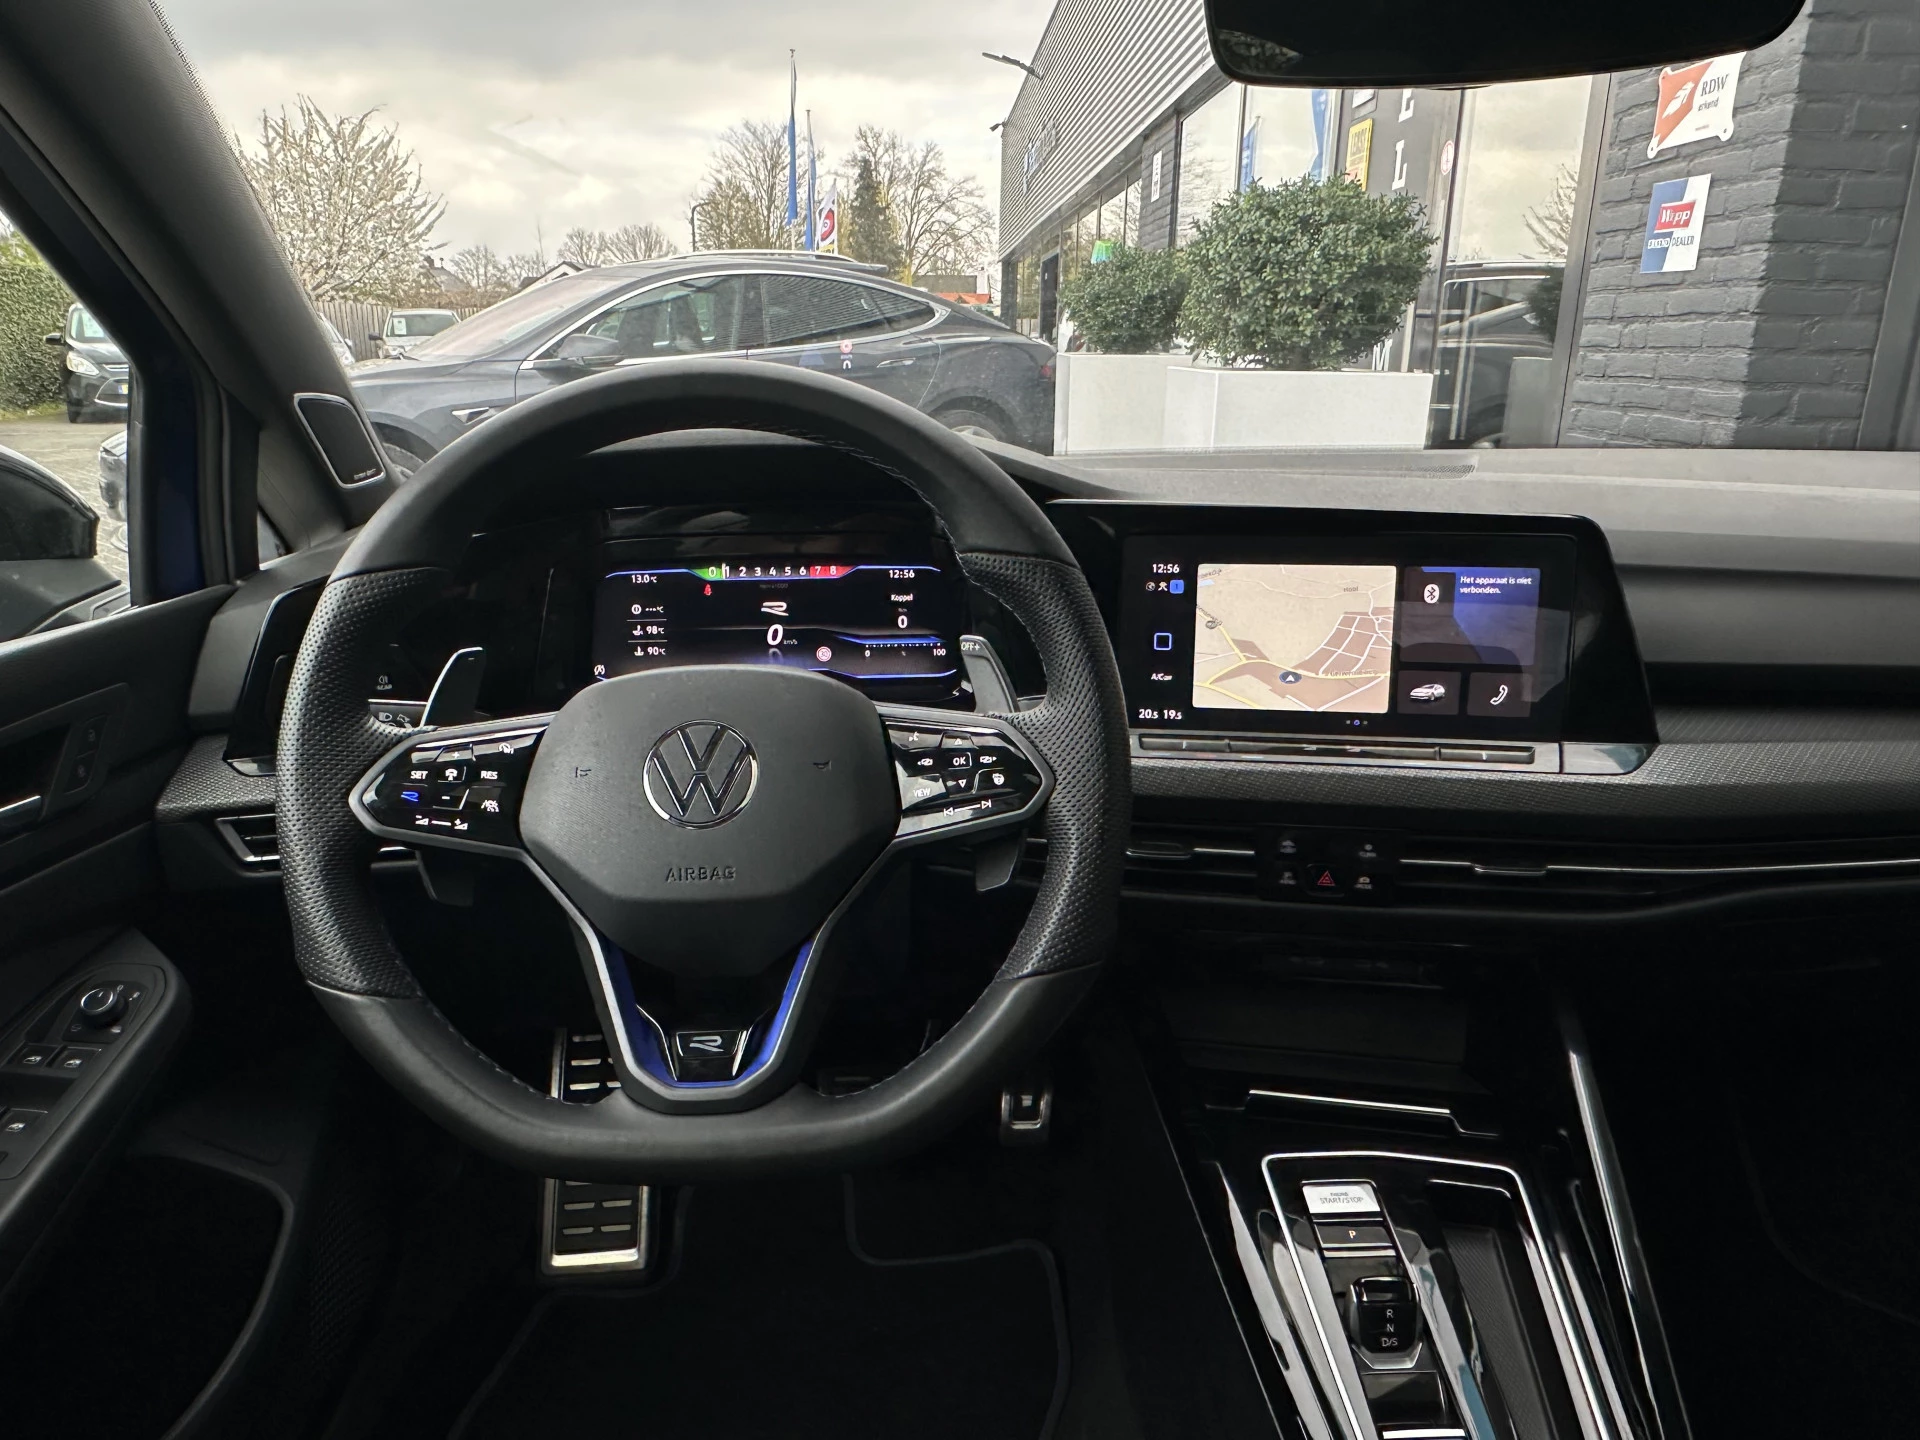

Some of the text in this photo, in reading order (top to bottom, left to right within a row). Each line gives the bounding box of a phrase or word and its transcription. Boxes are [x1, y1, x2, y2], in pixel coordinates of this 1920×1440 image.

[1701, 73, 1729, 96] RDW
[1672, 236, 1694, 246] DEALER
[708, 566, 716, 577] 0
[739, 567, 746, 577] 2
[754, 567, 761, 576] 3
[769, 567, 776, 576] 4
[784, 567, 792, 576] 5
[799, 566, 806, 575] 6
[815, 566, 821, 575] 7
[829, 566, 837, 575] 8
[1152, 563, 1180, 574] 12:56
[889, 570, 915, 578] 12:56
[1475, 576, 1507, 585] apparaat
[1509, 576, 1515, 584] is
[897, 615, 908, 628] 0
[766, 624, 783, 645] 0
[953, 757, 966, 766] OK
[411, 770, 428, 780] SET
[480, 770, 498, 780] RES
[913, 788, 930, 797] VIEW
[665, 866, 736, 883] AIRBAG
[1348, 1230, 1356, 1238] P
[1387, 1309, 1393, 1319] R
[1387, 1323, 1394, 1332] N
[1382, 1337, 1398, 1347] D/S
